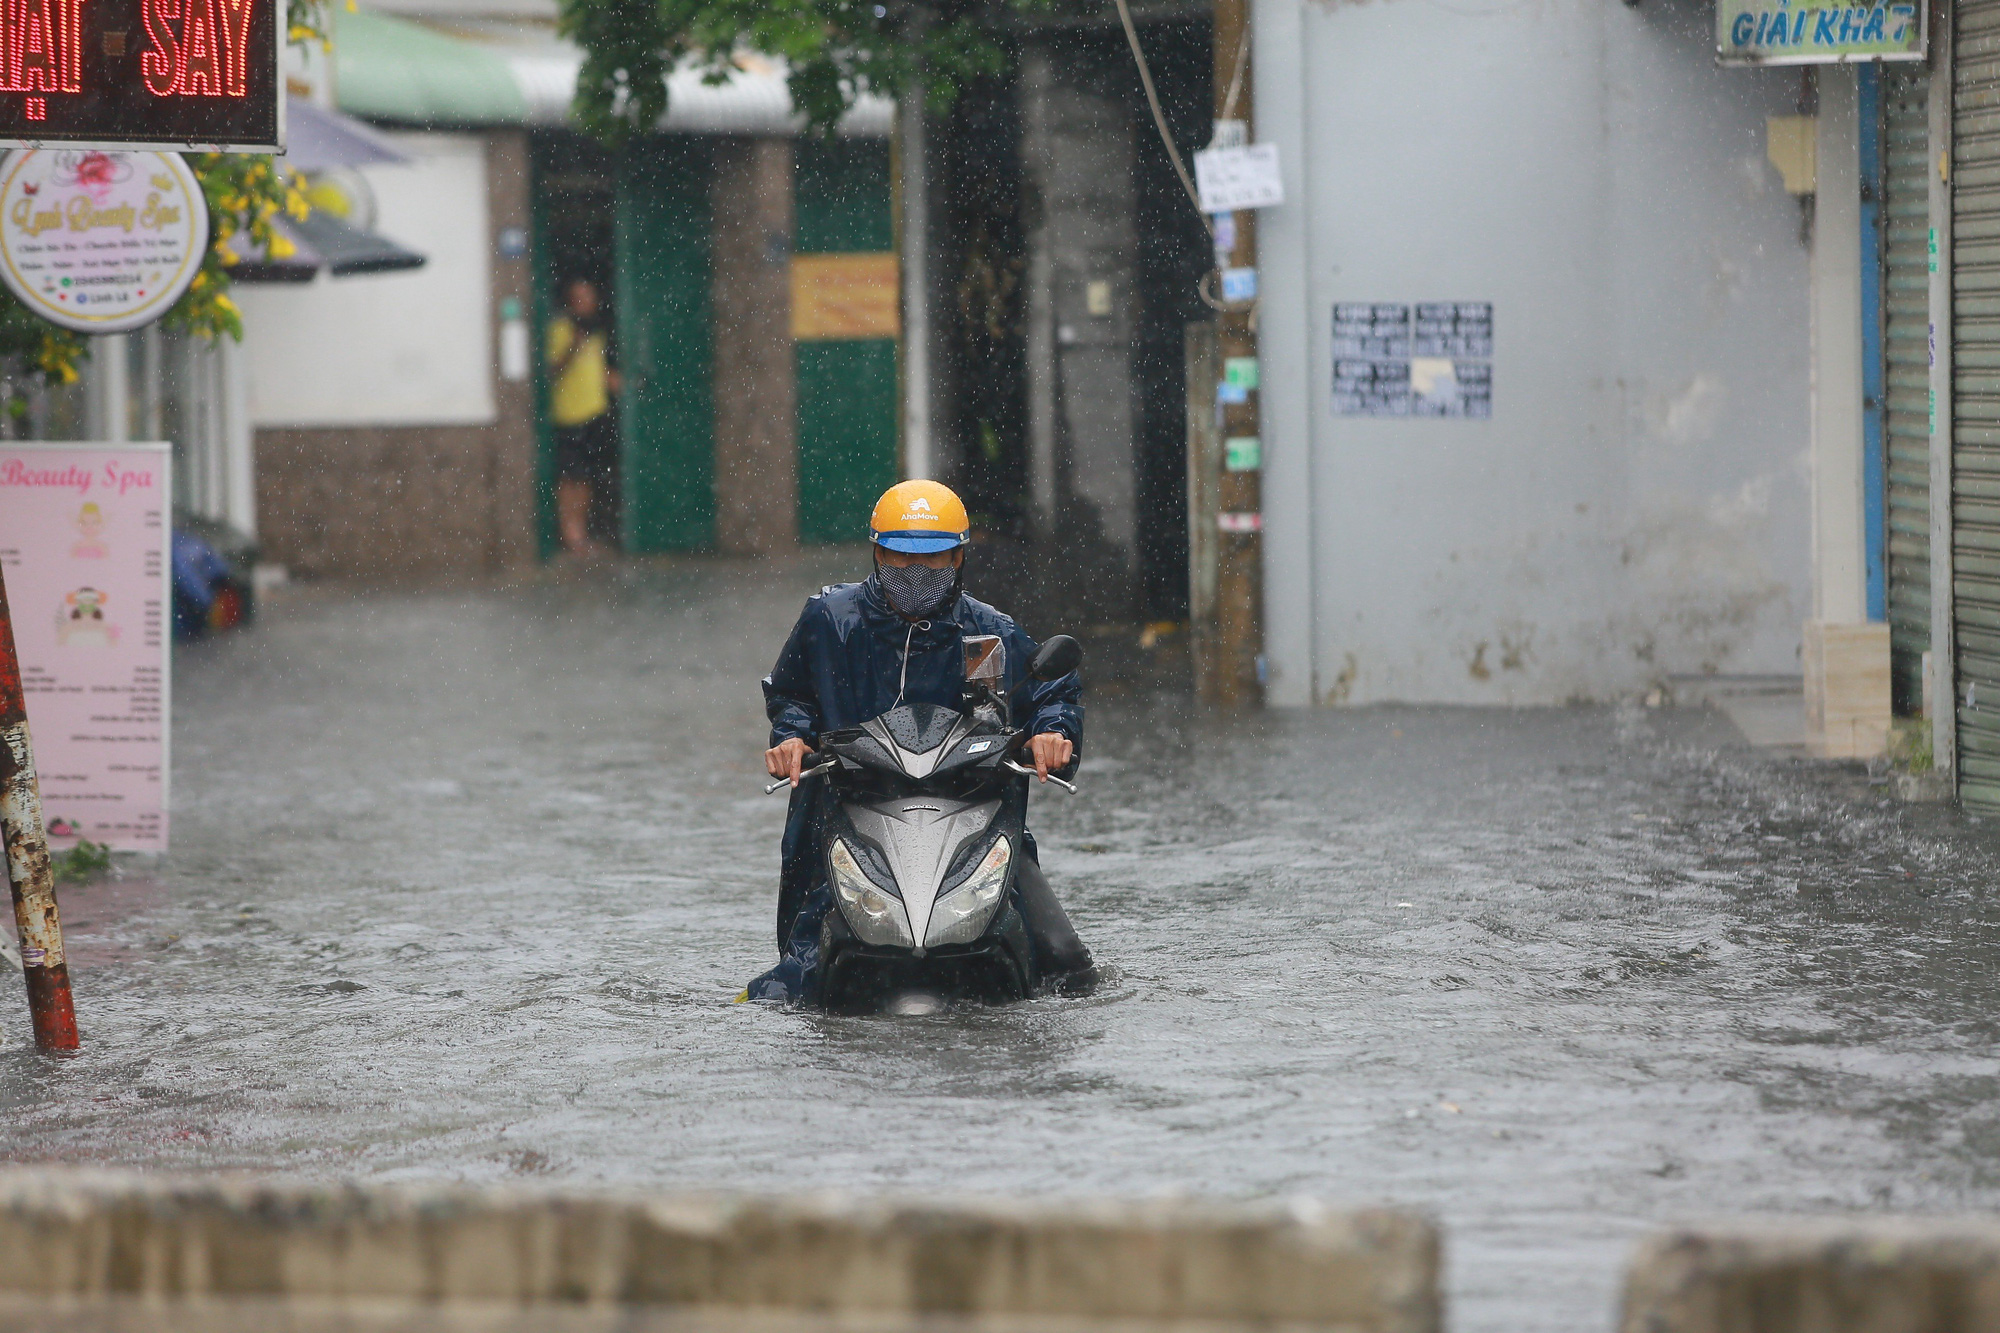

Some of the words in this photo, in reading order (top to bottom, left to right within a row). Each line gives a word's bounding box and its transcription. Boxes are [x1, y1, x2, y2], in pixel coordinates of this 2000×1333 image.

[0, 459, 92, 495] Beauty
[102, 460, 153, 495] Spa
[901, 512, 939, 521] AhaMove
